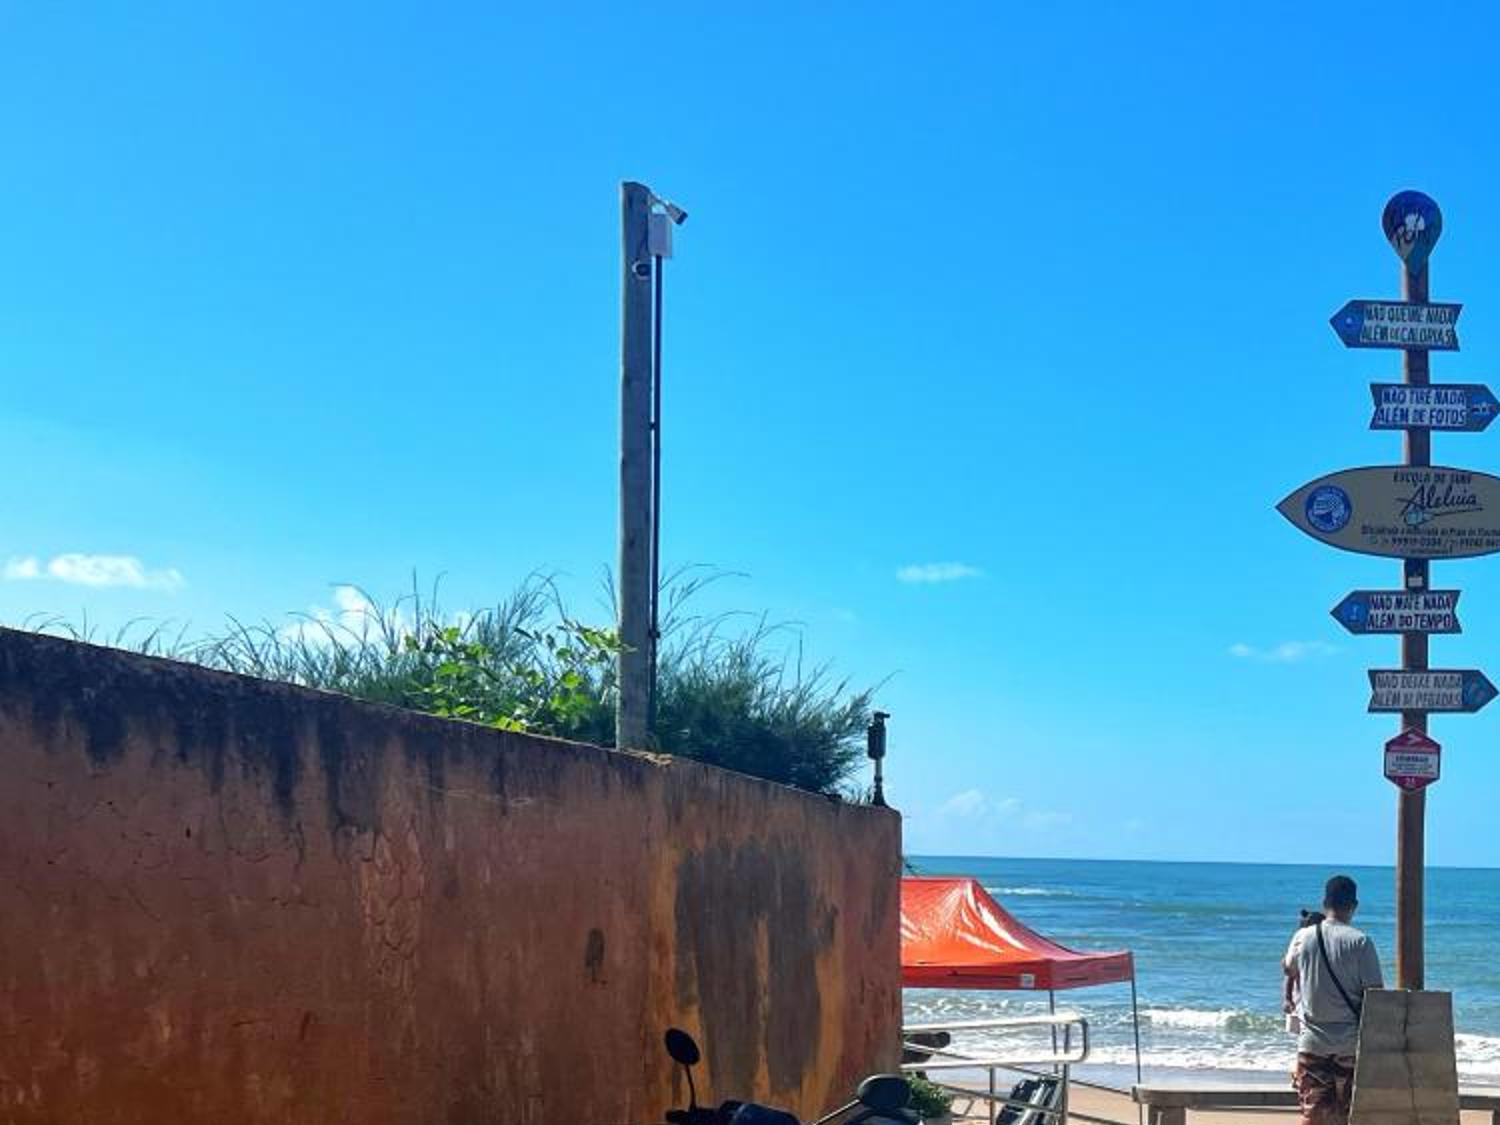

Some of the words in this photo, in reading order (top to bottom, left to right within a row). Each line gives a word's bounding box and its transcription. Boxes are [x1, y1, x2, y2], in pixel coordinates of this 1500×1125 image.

[1434, 389, 1465, 405] NADA
[1429, 409, 1466, 425] FOTOS
[1395, 484, 1477, 516] Aleluia
[1424, 594, 1452, 610] NADA
[1399, 614, 1412, 627] DO
[1413, 613, 1452, 629] TEMPO
